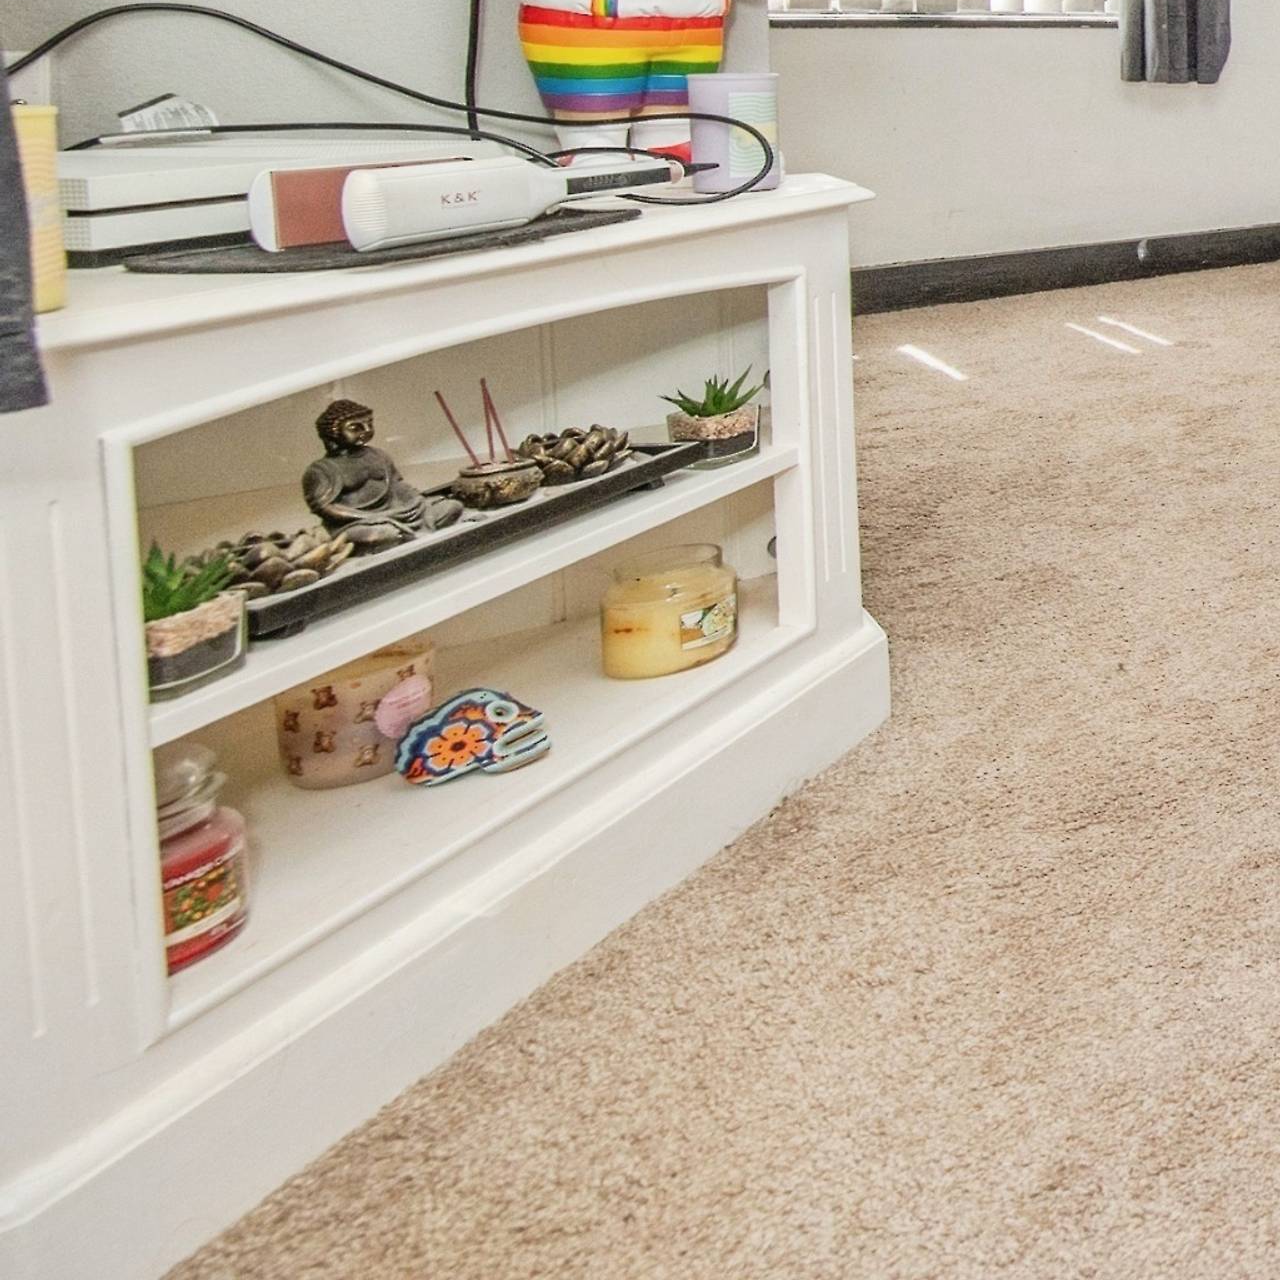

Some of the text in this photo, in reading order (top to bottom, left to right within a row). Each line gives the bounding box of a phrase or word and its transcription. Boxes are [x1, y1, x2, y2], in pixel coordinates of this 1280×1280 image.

[440, 191, 478, 205] K & K
